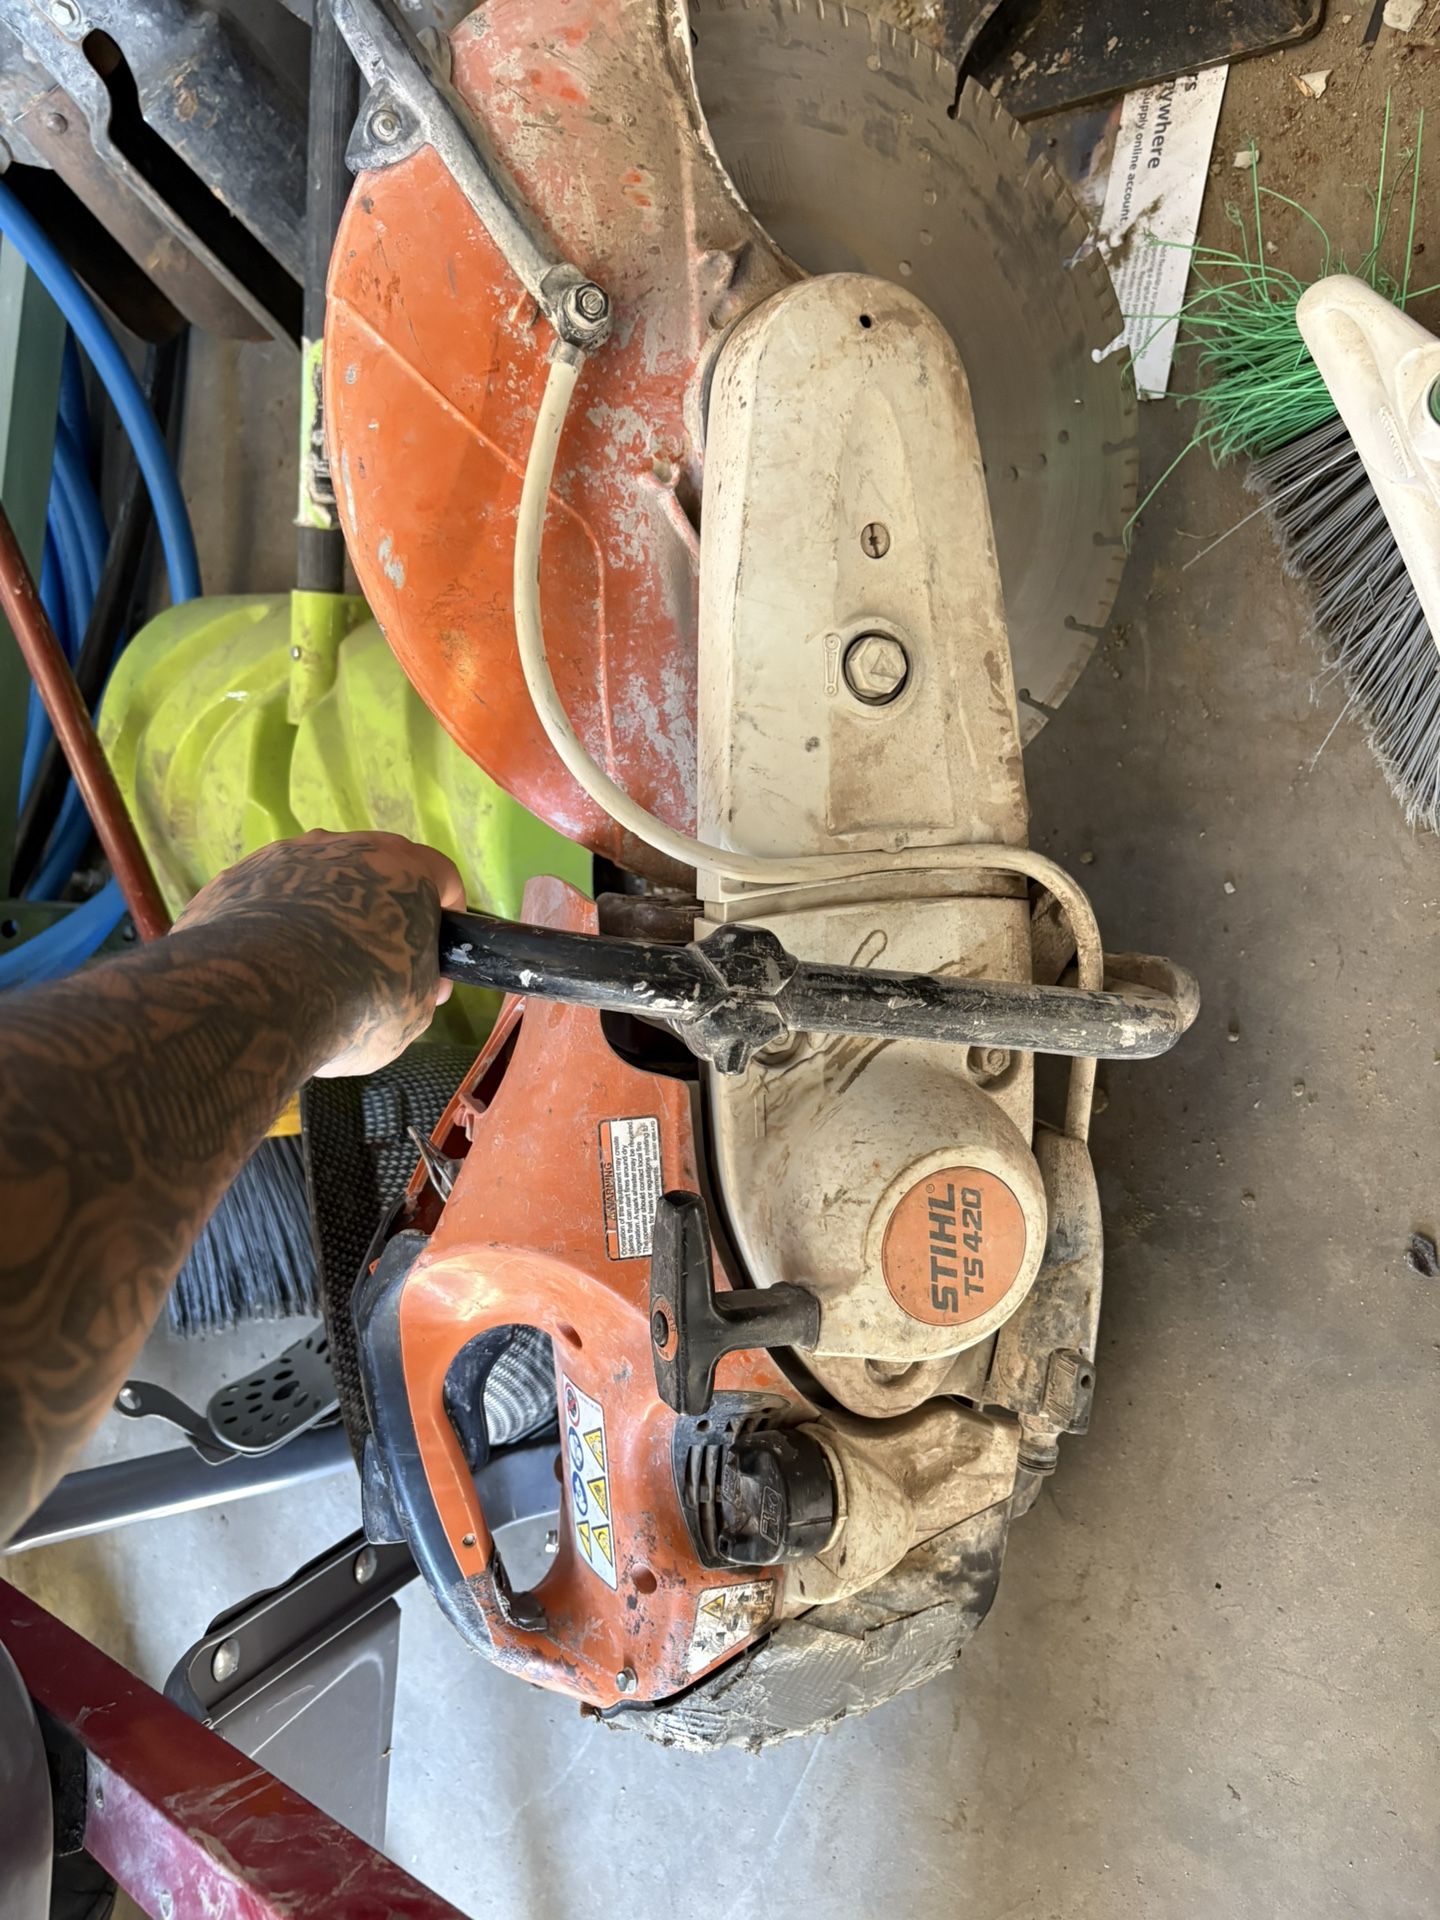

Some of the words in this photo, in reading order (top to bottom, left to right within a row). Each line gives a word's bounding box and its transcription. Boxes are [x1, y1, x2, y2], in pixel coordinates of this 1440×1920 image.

[1136, 91, 1154, 130] Supply
[1129, 133, 1144, 170] online
[629, 1149, 635, 1157] be
[604, 1162, 615, 1212] WARNING
[645, 1157, 653, 1191] regulations
[961, 1187, 982, 1252] 420
[928, 1184, 958, 1313] STIHL
[963, 1257, 983, 1296] TS
